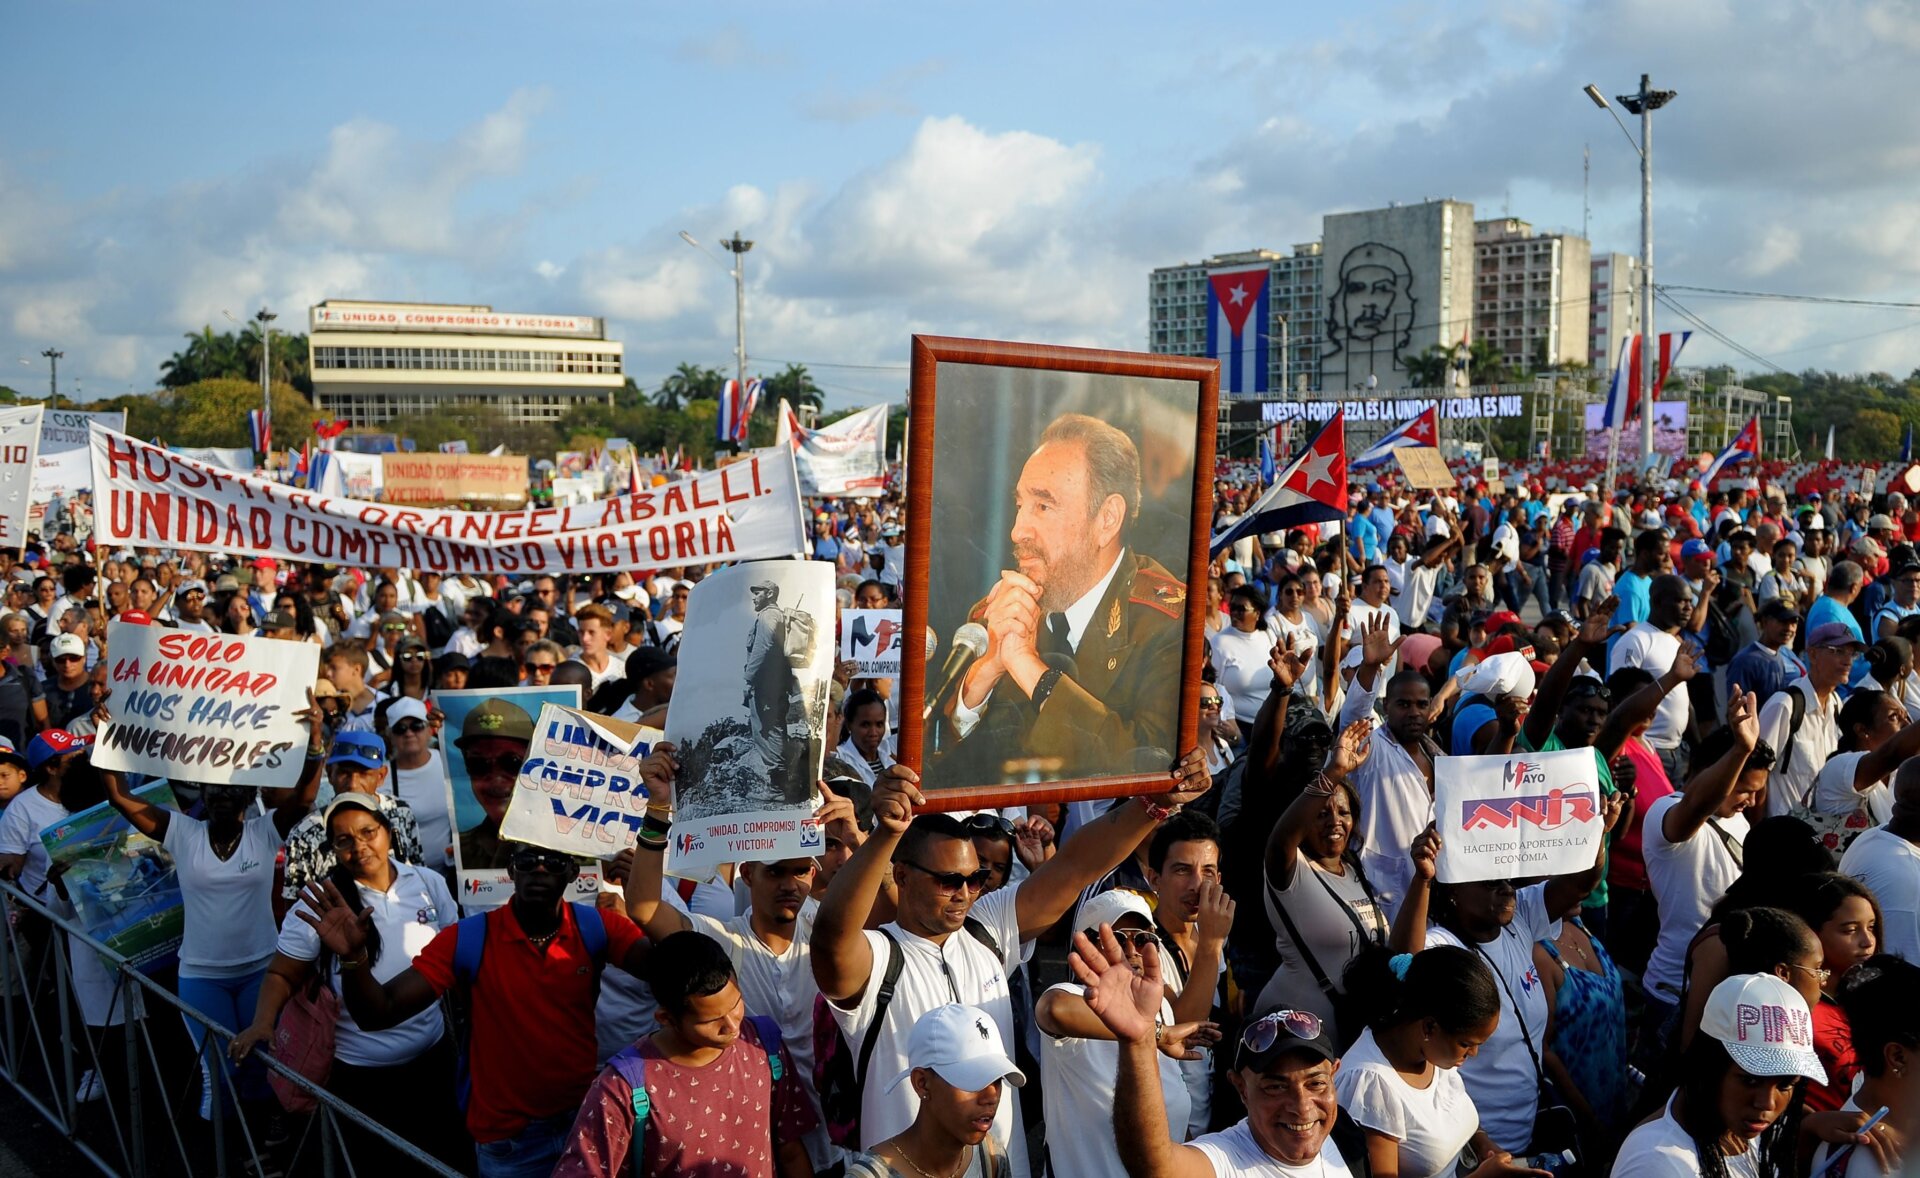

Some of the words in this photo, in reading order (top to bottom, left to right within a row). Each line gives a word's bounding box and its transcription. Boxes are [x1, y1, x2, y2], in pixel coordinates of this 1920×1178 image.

[1307, 400, 1364, 421] FORTEZA
[1365, 400, 1379, 420] ES
[1380, 399, 1395, 420] LA
[1483, 396, 1498, 418] ES
[1498, 395, 1523, 417] NUE
[110, 489, 273, 550] UNIDAD
[284, 513, 546, 572] COMPROMISO
[555, 515, 736, 570] VICTORIA
[113, 657, 142, 682] LA
[147, 661, 277, 699] UNIDAD
[124, 689, 184, 722] NOS
[187, 695, 281, 730] HACE
[102, 722, 294, 771] INVENCIBLES
[727, 840, 734, 852] Y
[743, 820, 796, 834] COMPROMISO
[1463, 842, 1517, 854] HACIENDO
[1519, 838, 1563, 850] APORTES
[1565, 838, 1573, 846] A
[1575, 837, 1588, 846] LA
[1736, 1003, 1811, 1046] PINK
